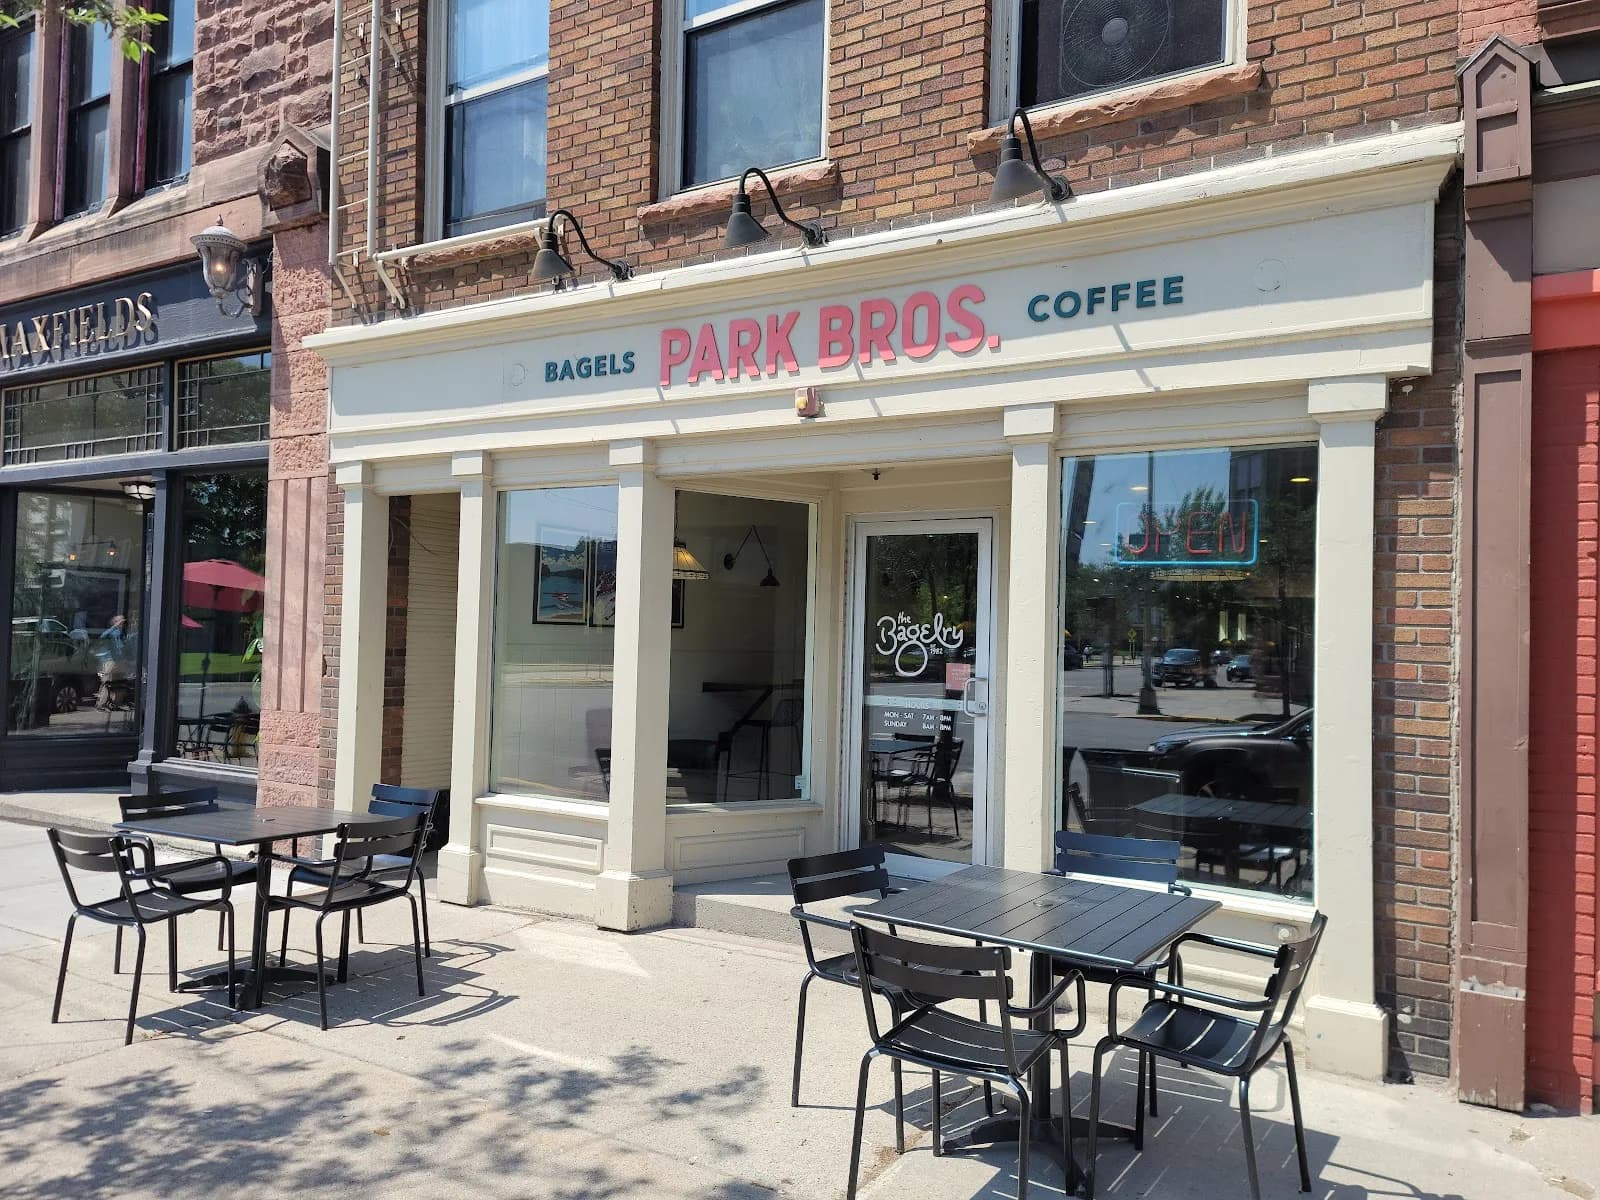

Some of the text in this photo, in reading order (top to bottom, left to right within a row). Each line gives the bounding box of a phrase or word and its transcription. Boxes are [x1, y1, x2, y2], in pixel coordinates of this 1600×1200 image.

[1028, 275, 1184, 322] COFFEE
[660, 284, 1000, 386] PARK BROS.
[545, 351, 635, 382] BAGELS
[898, 611, 911, 624] the
[876, 612, 964, 677] Bagelry
[903, 712, 914, 720] SAT
